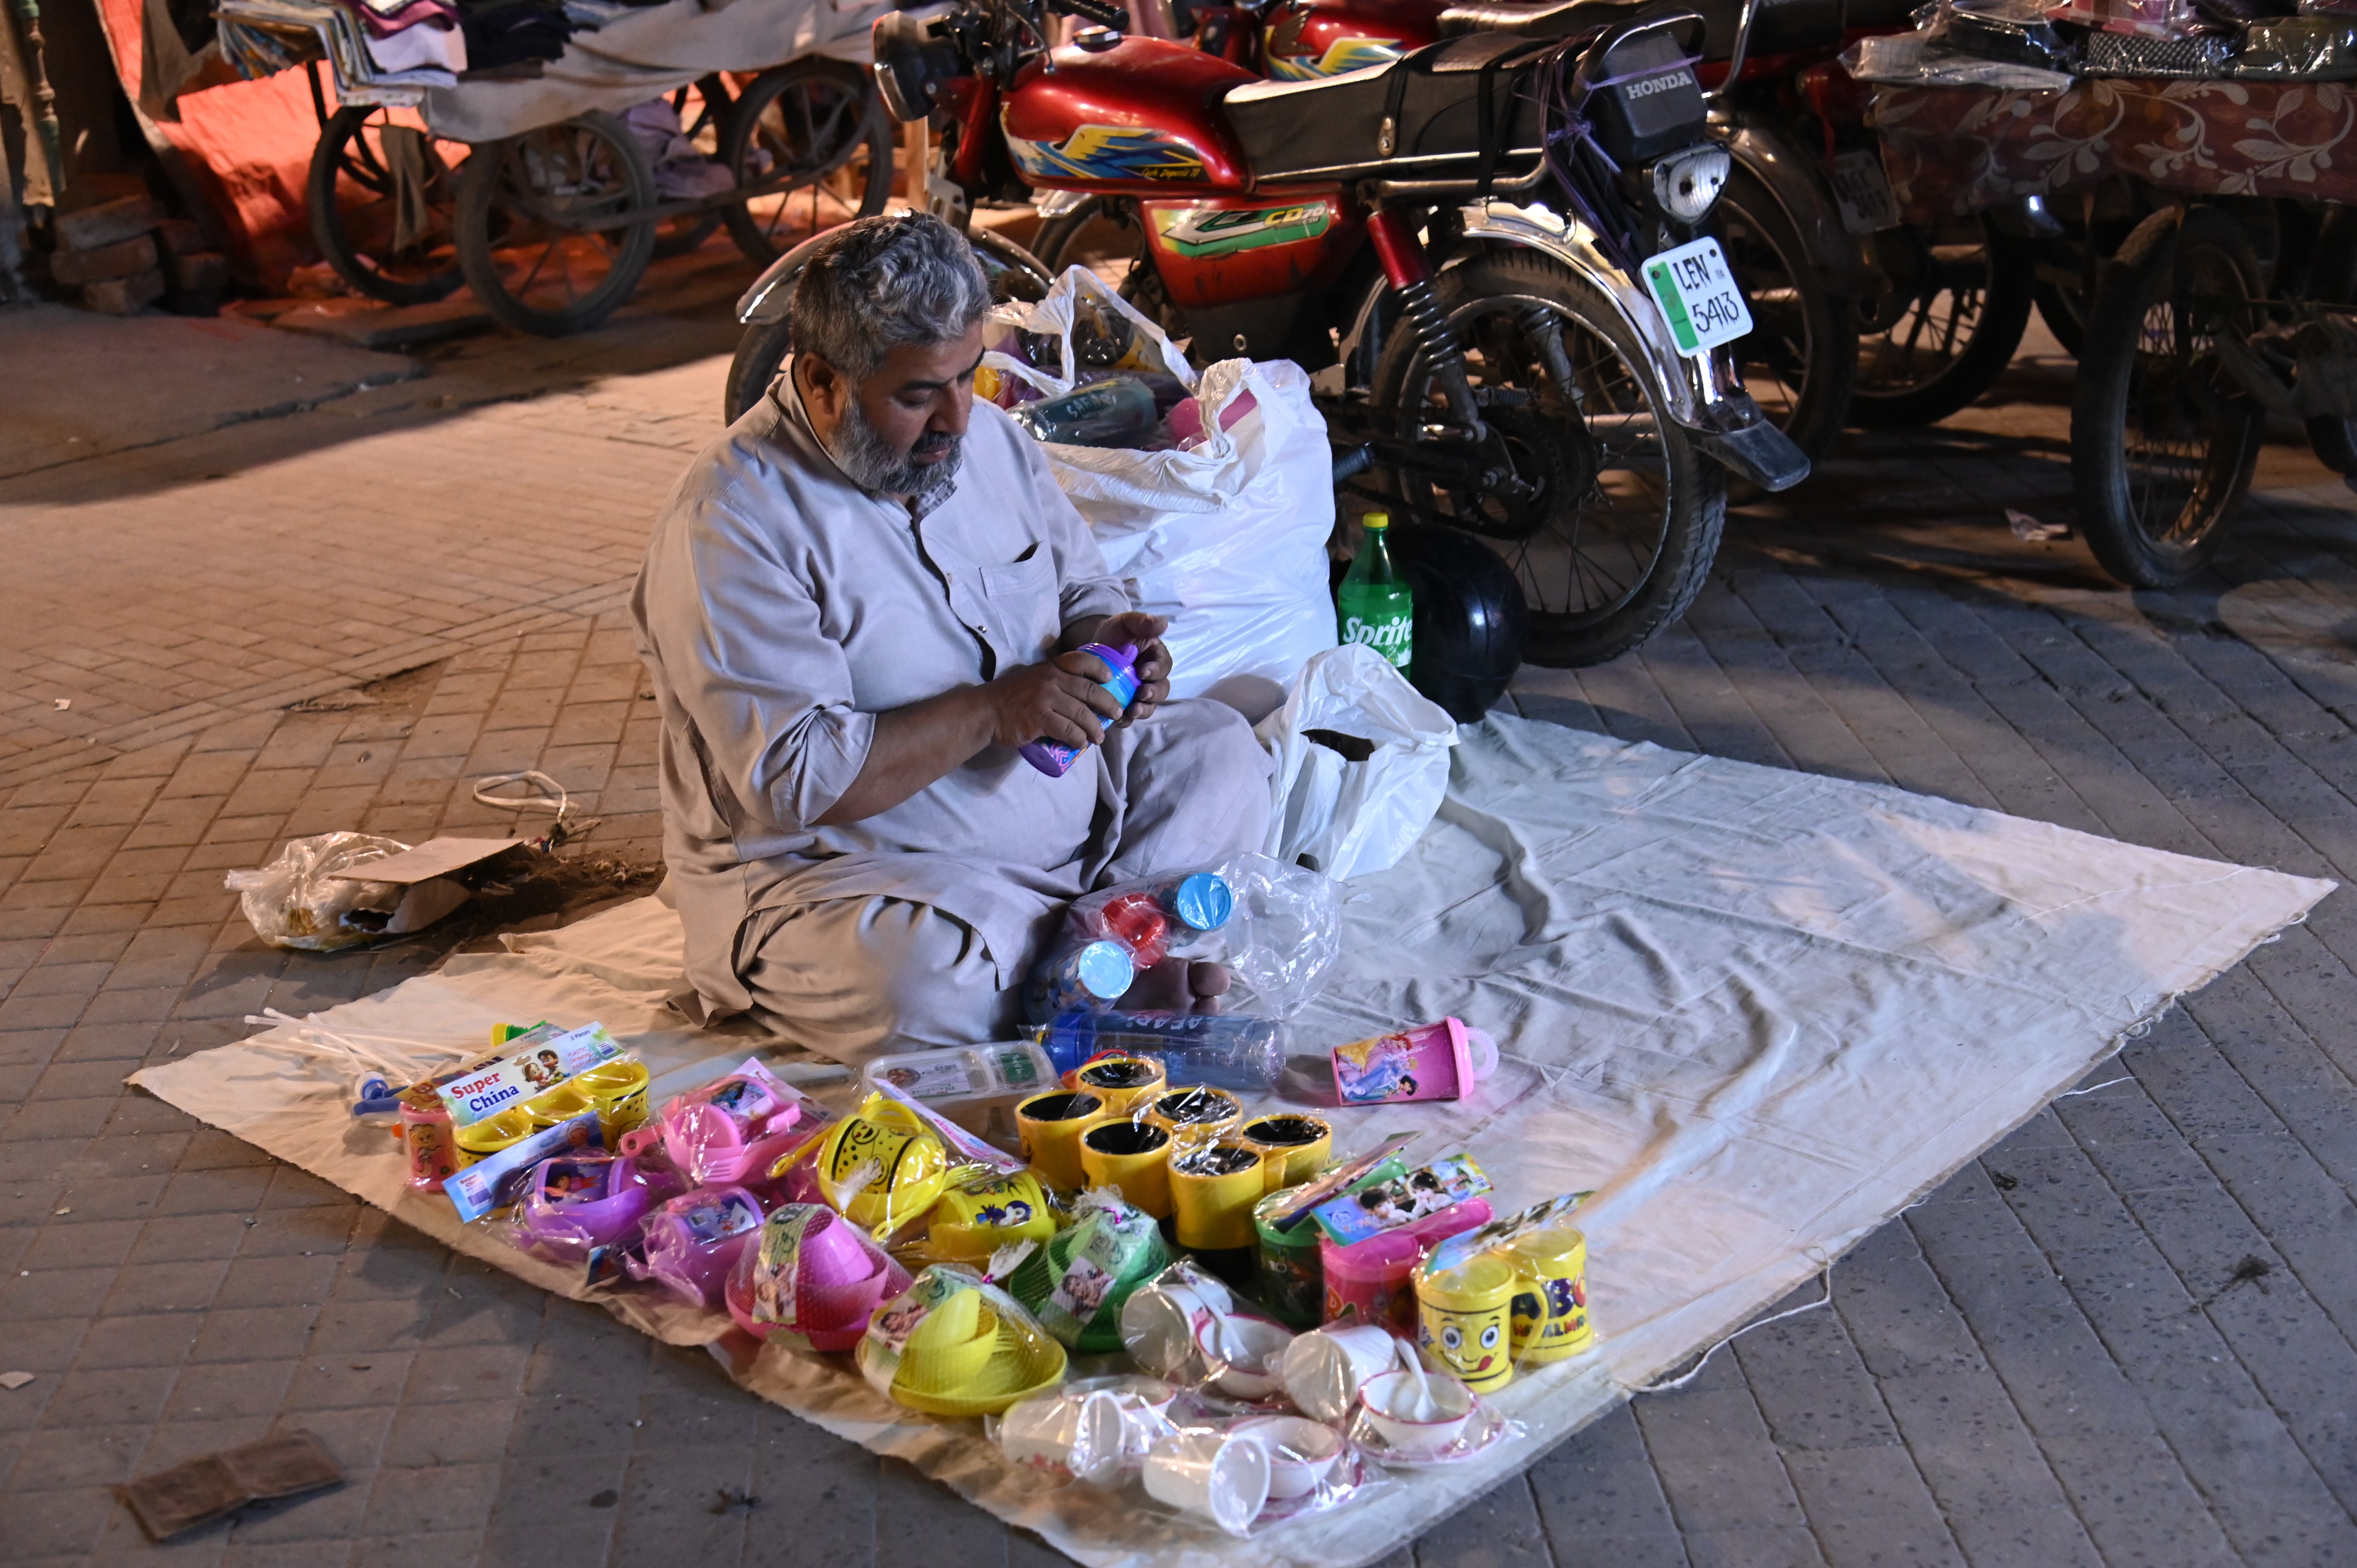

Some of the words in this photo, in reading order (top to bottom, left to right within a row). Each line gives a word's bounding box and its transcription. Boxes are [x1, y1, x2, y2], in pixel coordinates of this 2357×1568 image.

[1626, 71, 1693, 99] HONDA
[1673, 254, 1712, 293] LEN
[1692, 291, 1740, 335] 5413
[1343, 616, 1412, 646] Sprite
[574, 1030, 590, 1039] Pieces
[567, 1046, 587, 1057] PLASTIC
[451, 1072, 500, 1099] Super
[470, 1086, 519, 1112] China
